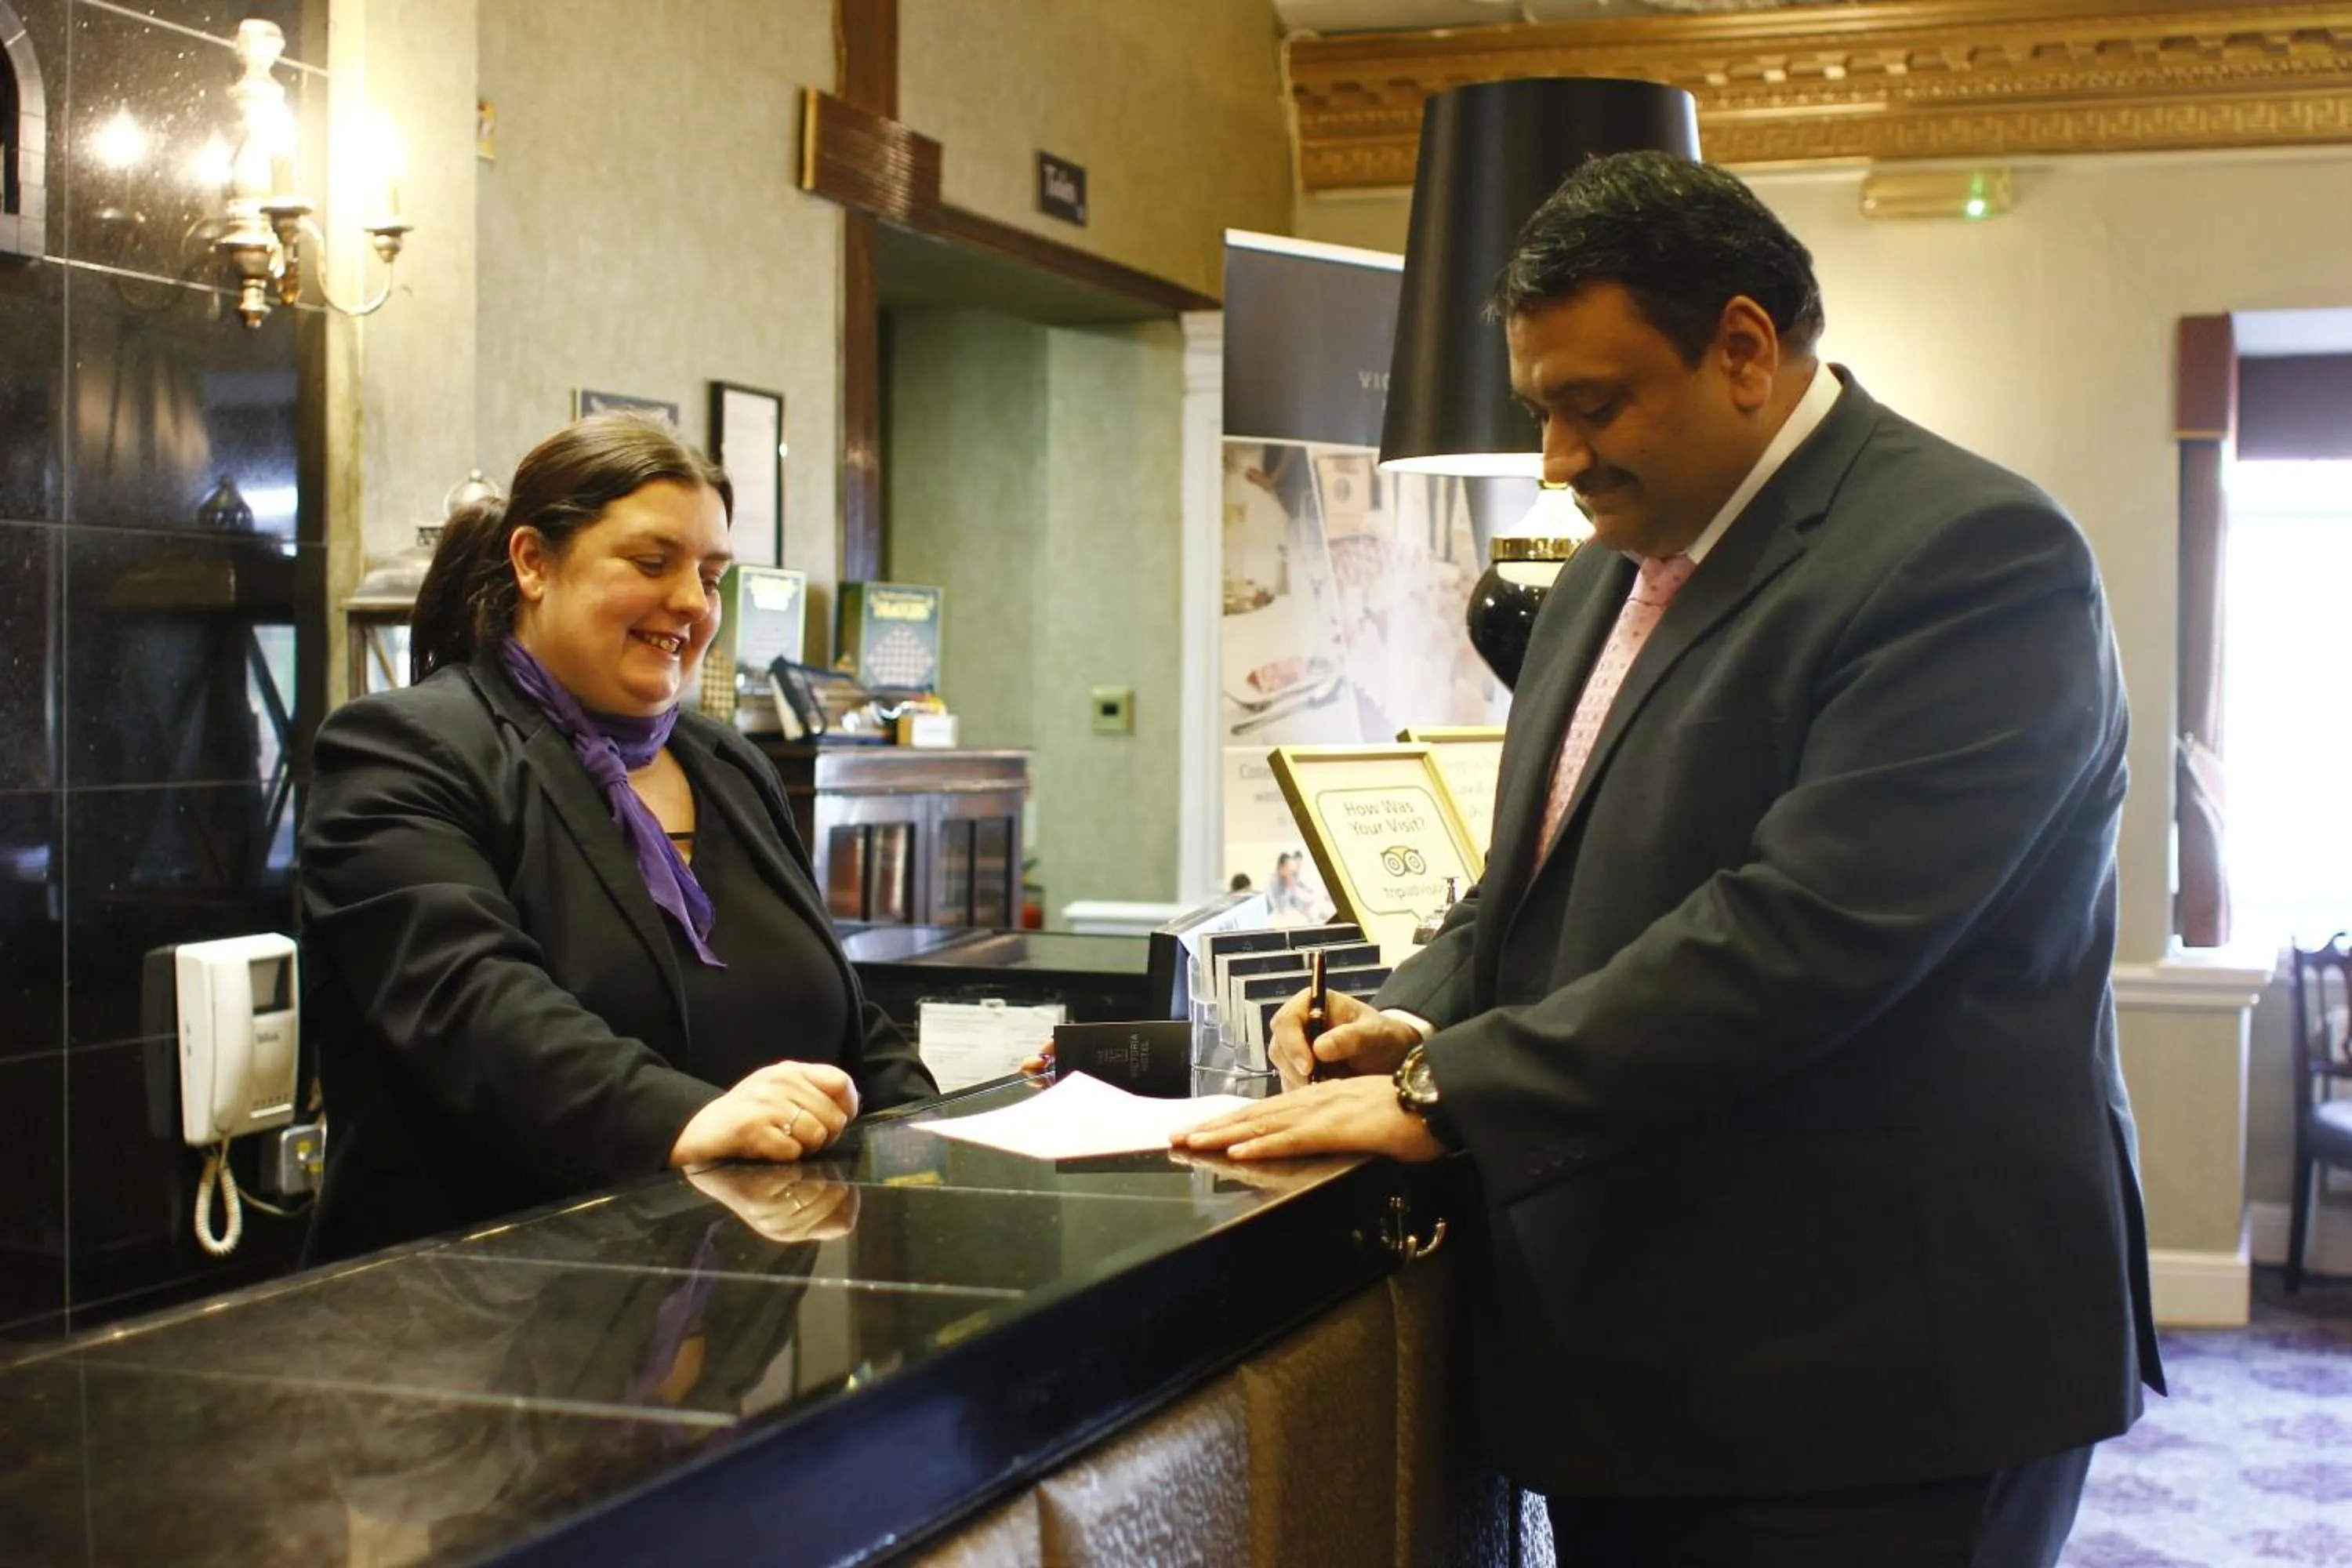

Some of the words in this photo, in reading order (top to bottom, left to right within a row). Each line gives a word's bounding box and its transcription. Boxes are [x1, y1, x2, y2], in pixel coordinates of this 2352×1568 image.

[1344, 802, 1379, 816] How
[1381, 800, 1414, 814] Was
[1349, 821, 1382, 835] Your
[1385, 817, 1425, 833] Visit?
